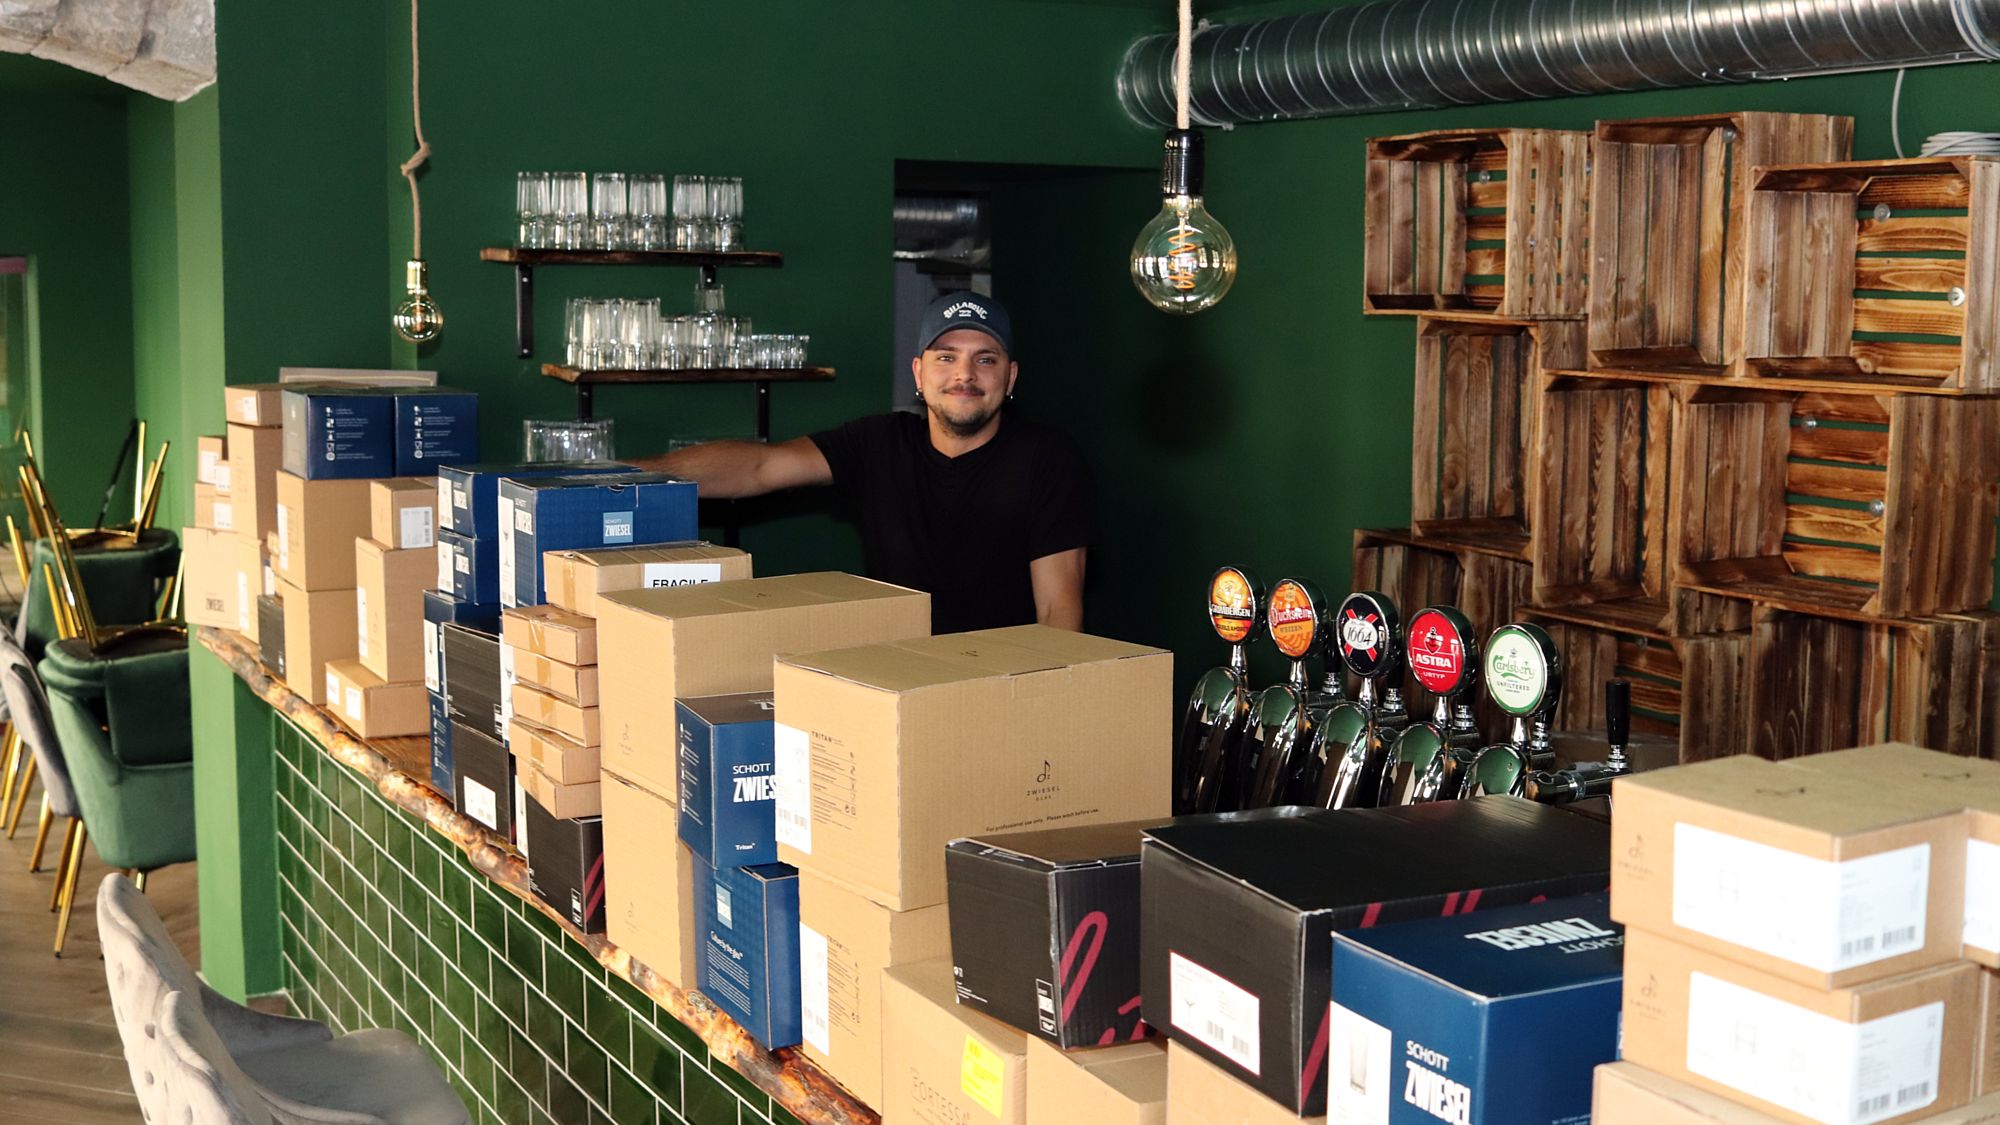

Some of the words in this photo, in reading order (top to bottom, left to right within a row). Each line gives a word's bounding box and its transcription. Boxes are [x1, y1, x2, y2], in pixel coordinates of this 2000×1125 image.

[605, 524, 631, 536] ZWIESEL
[1347, 626, 1372, 645] 1664
[1415, 653, 1453, 668] ASTRA
[1493, 655, 1535, 681] Carlsberg
[1422, 671, 1446, 680] URTYP
[732, 762, 771, 775] SCHOTT
[732, 774, 776, 803] ZWIES
[1026, 785, 1060, 796] ZWIESEL
[1464, 917, 1616, 951] ZWIESEL
[1406, 1040, 1450, 1072] SCHOTT
[1404, 1060, 1471, 1125] ZWIESEL
